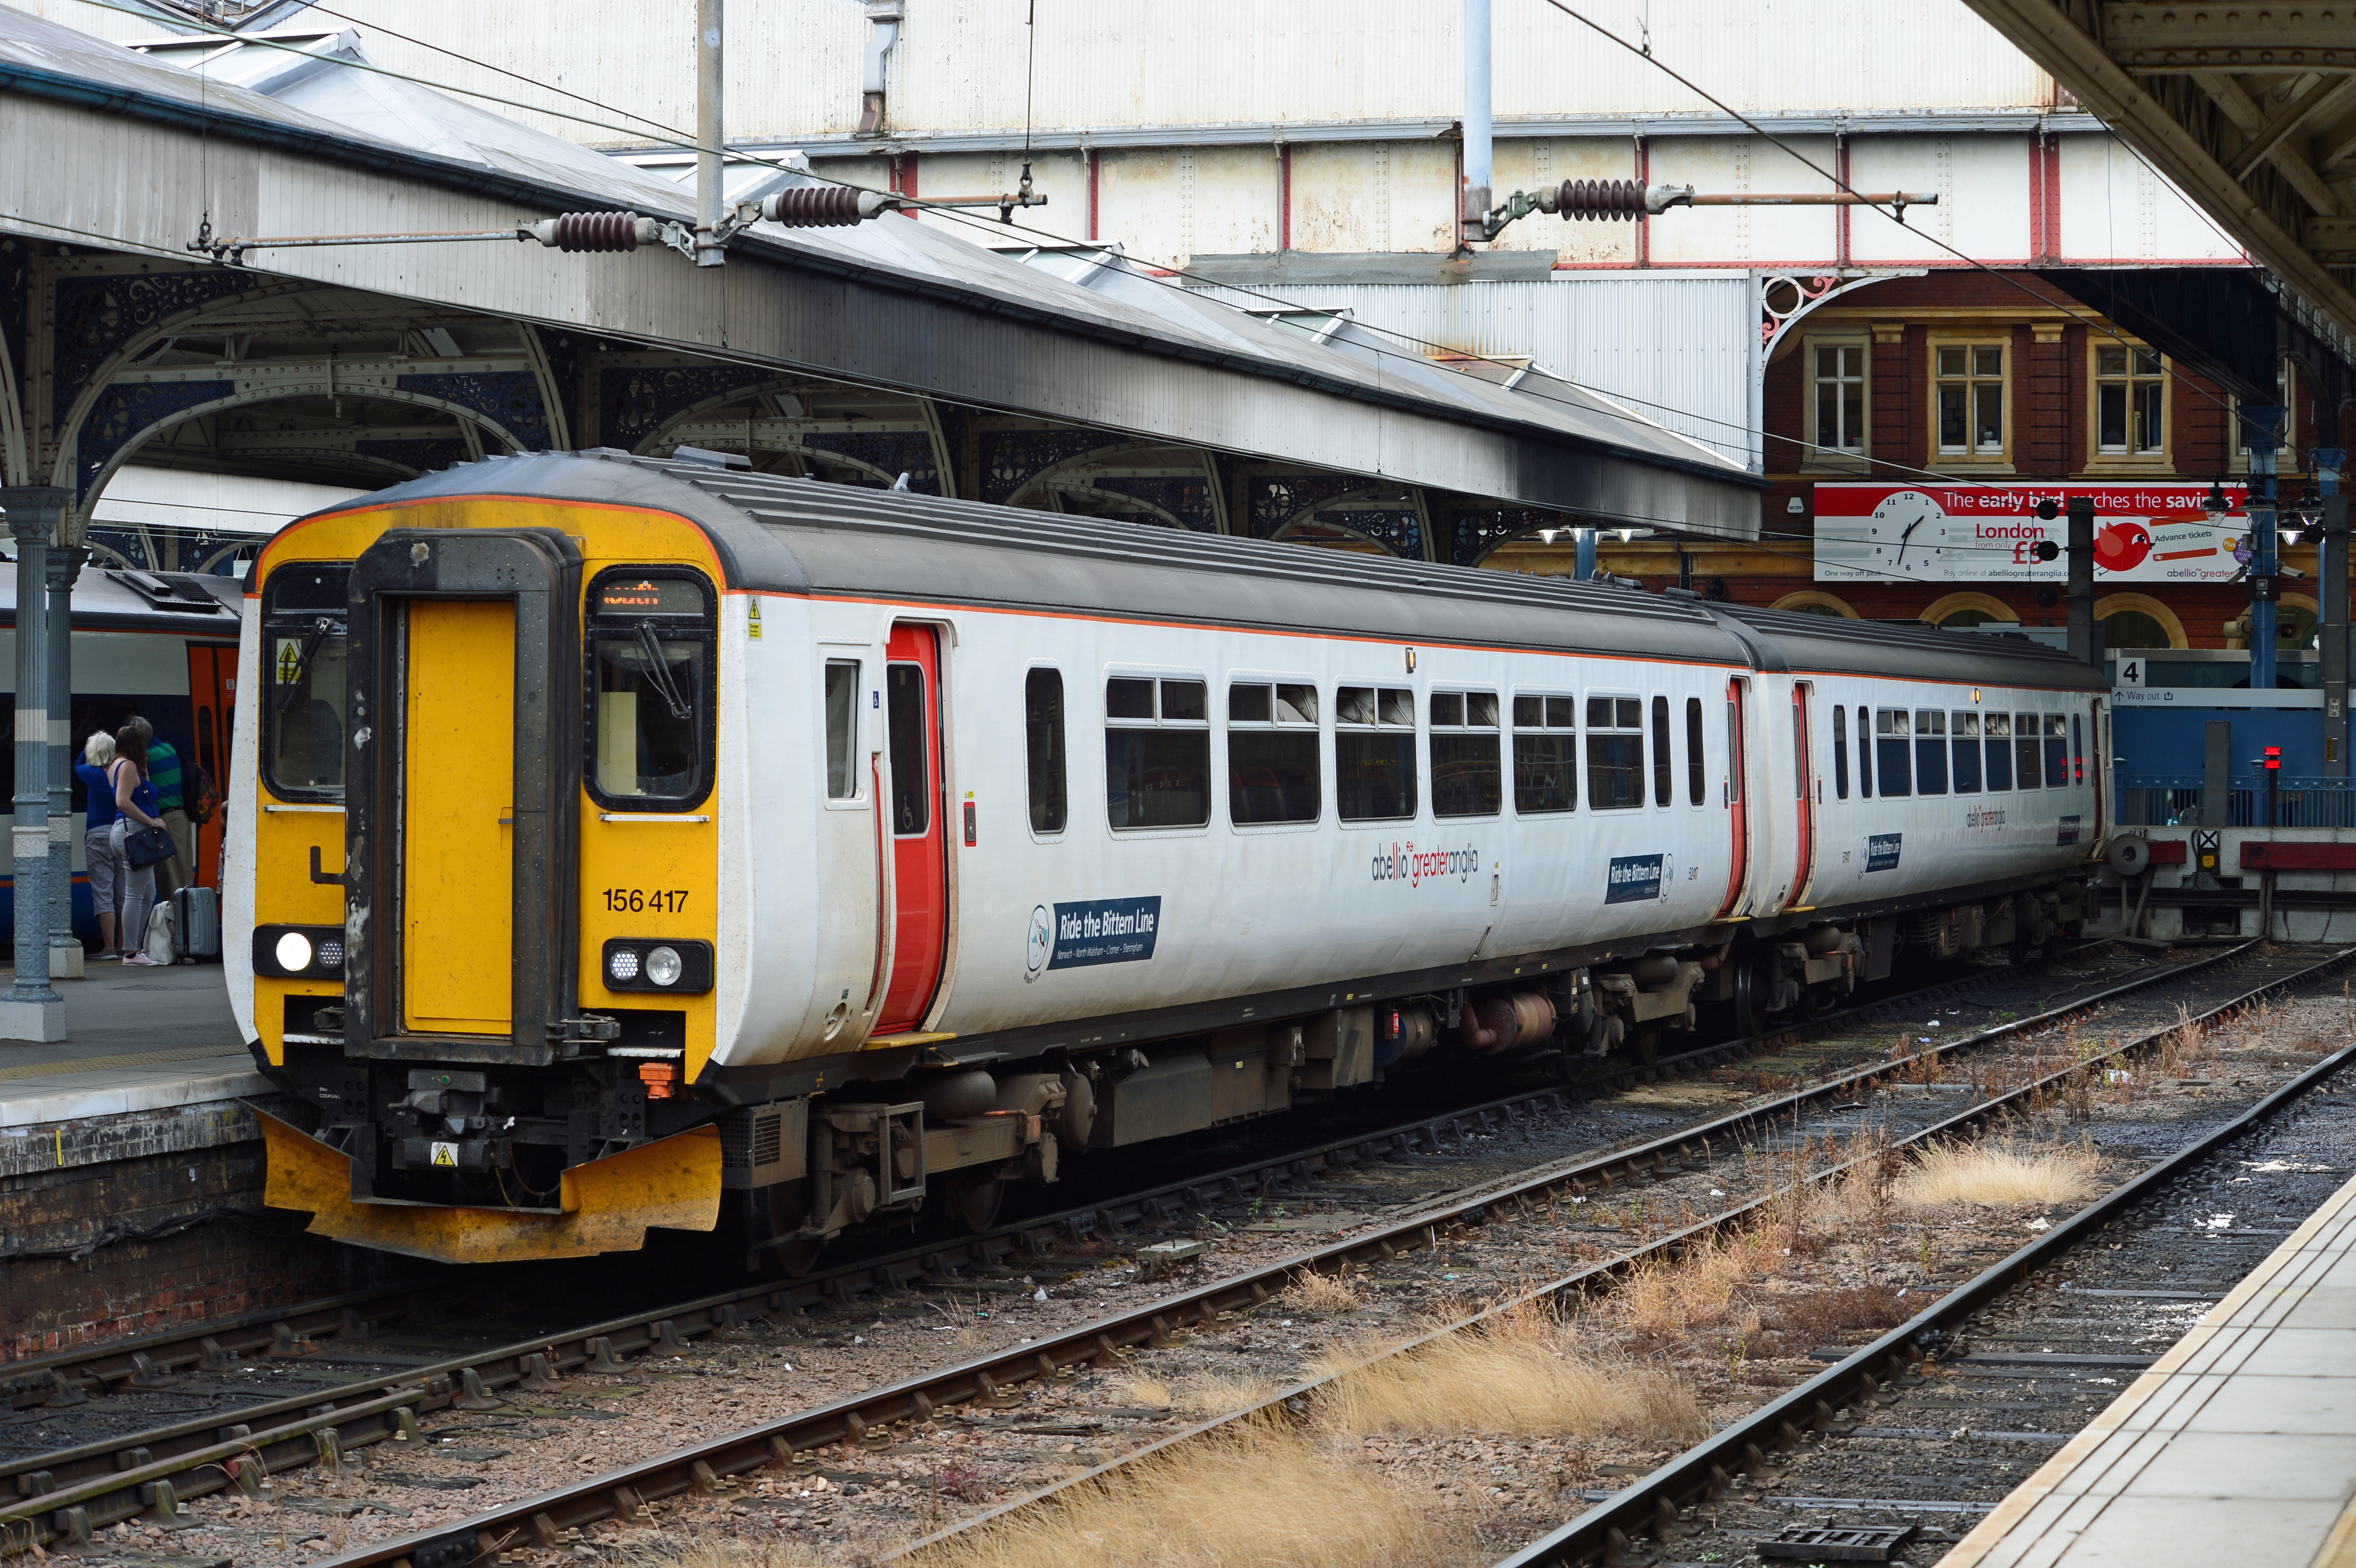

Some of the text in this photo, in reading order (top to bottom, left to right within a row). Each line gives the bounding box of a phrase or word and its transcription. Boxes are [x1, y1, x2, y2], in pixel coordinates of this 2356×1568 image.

[1944, 491, 1974, 507] The
[1979, 491, 2024, 512] early
[2072, 491, 2130, 508] ches
[2135, 491, 2161, 508] the
[2166, 492, 2233, 508] savis
[1976, 523, 2044, 538] London
[2155, 530, 2212, 542] Advance tickets
[1996, 541, 2011, 550] only
[2167, 568, 2234, 579] abellio greater
[2123, 662, 2138, 682] 4
[2127, 691, 2145, 702] Way
[1883, 840, 1893, 855] Bittern
[1372, 842, 1478, 888] abellio greateranglia
[1611, 861, 1660, 884] Ride the Bittern Line
[602, 889, 689, 913] 156 417
[1060, 907, 1154, 940] Ride the Bittern Line
[1057, 942, 1143, 960] Norwich North Walsham Cromer Sheringham
